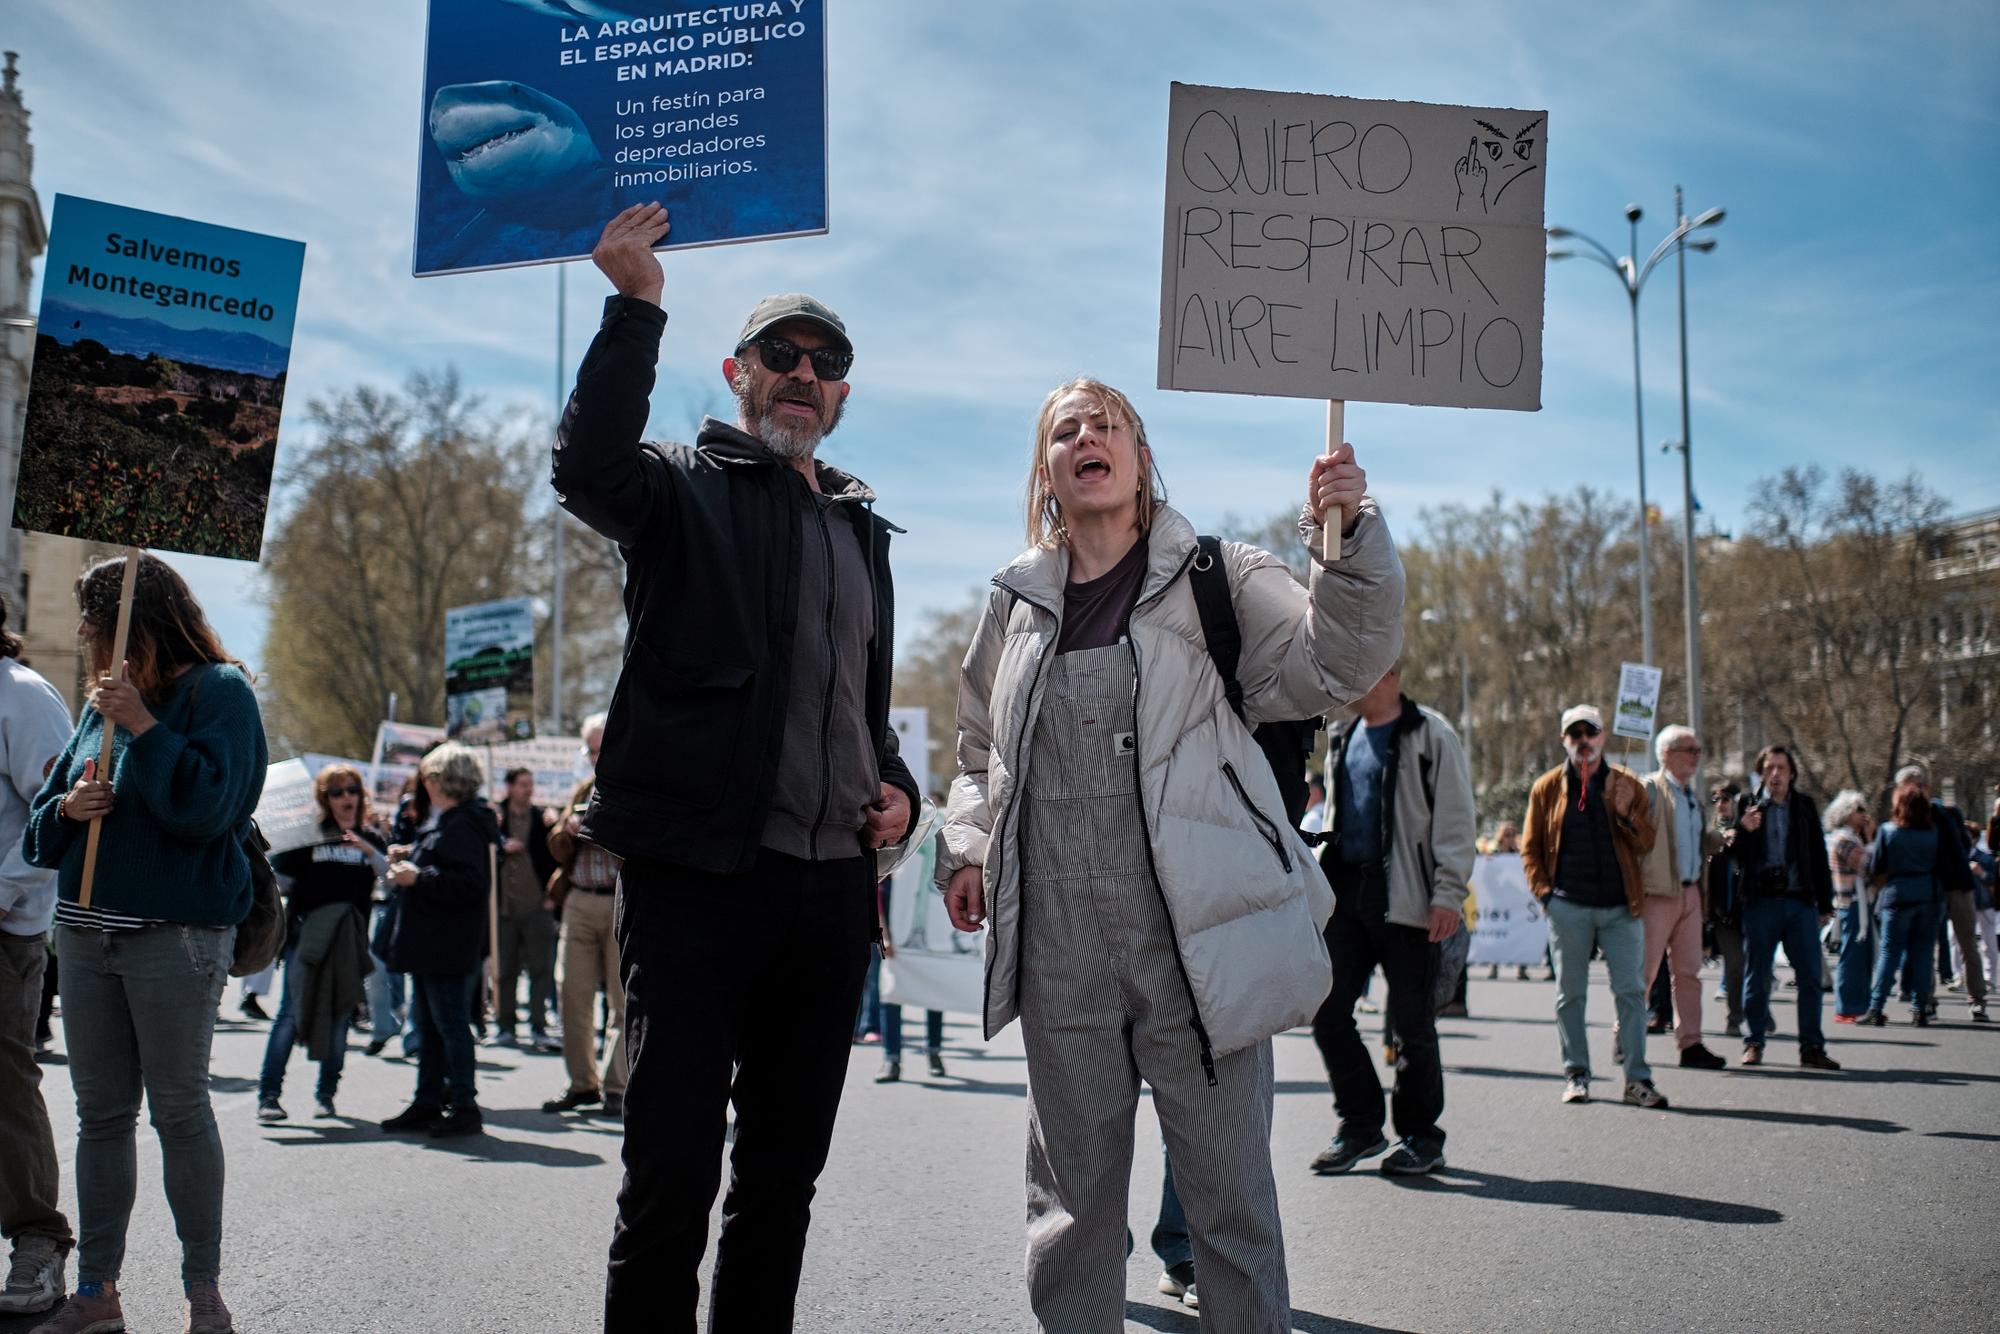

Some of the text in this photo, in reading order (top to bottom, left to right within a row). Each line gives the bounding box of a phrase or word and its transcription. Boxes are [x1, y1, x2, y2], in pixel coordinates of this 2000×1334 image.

[560, 20, 806, 66] EL ESPACIO PÚBLICO
[561, 0, 805, 43] LA ARQUITECTURA Y
[616, 52, 754, 82] EN MADRID:
[616, 85, 765, 117] Un festín para
[615, 112, 739, 140] los grandes
[615, 133, 766, 165] depredadores
[1182, 109, 1412, 196] QUIERO
[614, 159, 758, 188] inmobiliarios.
[105, 232, 241, 278] Salvemos
[1182, 207, 1500, 306] RESPIRAR
[67, 264, 275, 321] Montegancedo
[1177, 293, 1524, 388] AIRE LIMPIO
